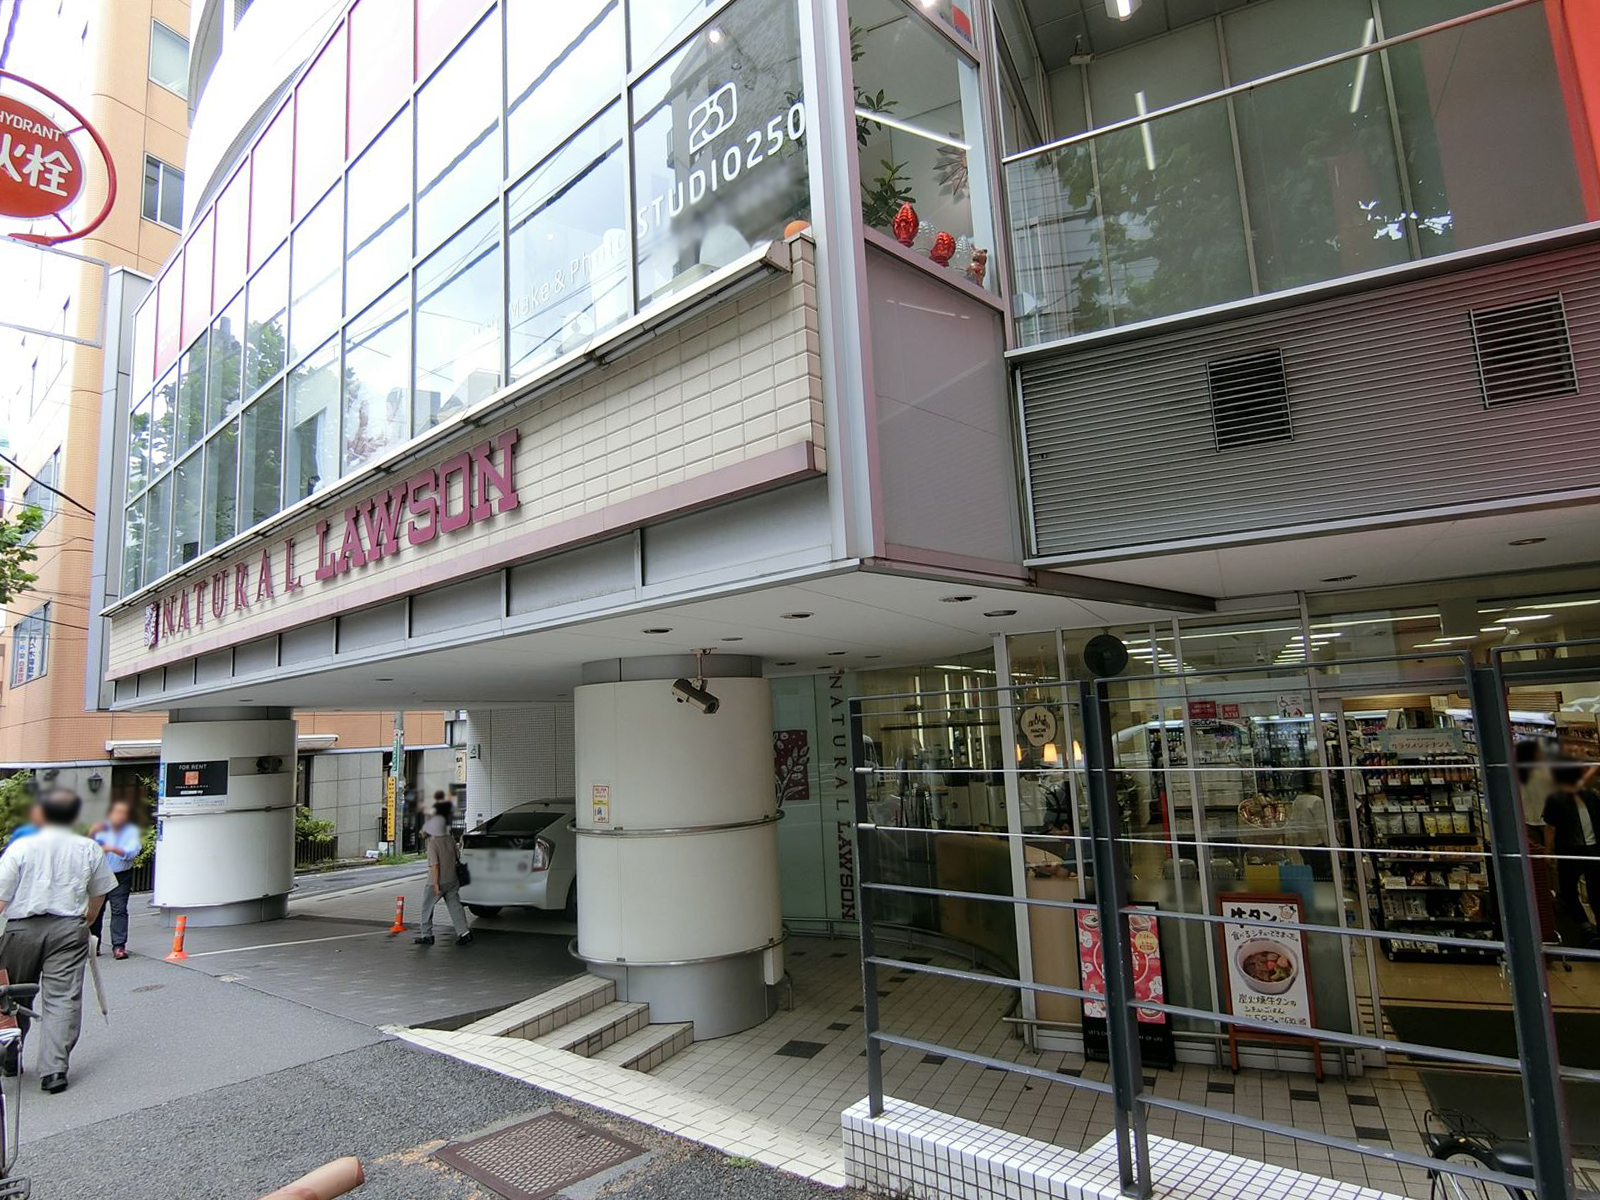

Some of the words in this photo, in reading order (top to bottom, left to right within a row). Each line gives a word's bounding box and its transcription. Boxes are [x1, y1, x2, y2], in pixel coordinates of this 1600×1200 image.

[160, 537, 303, 638] NATURAL
[314, 428, 521, 581] LAWSON
[828, 675, 851, 811] NATURAL
[836, 821, 856, 919] LAWSON
